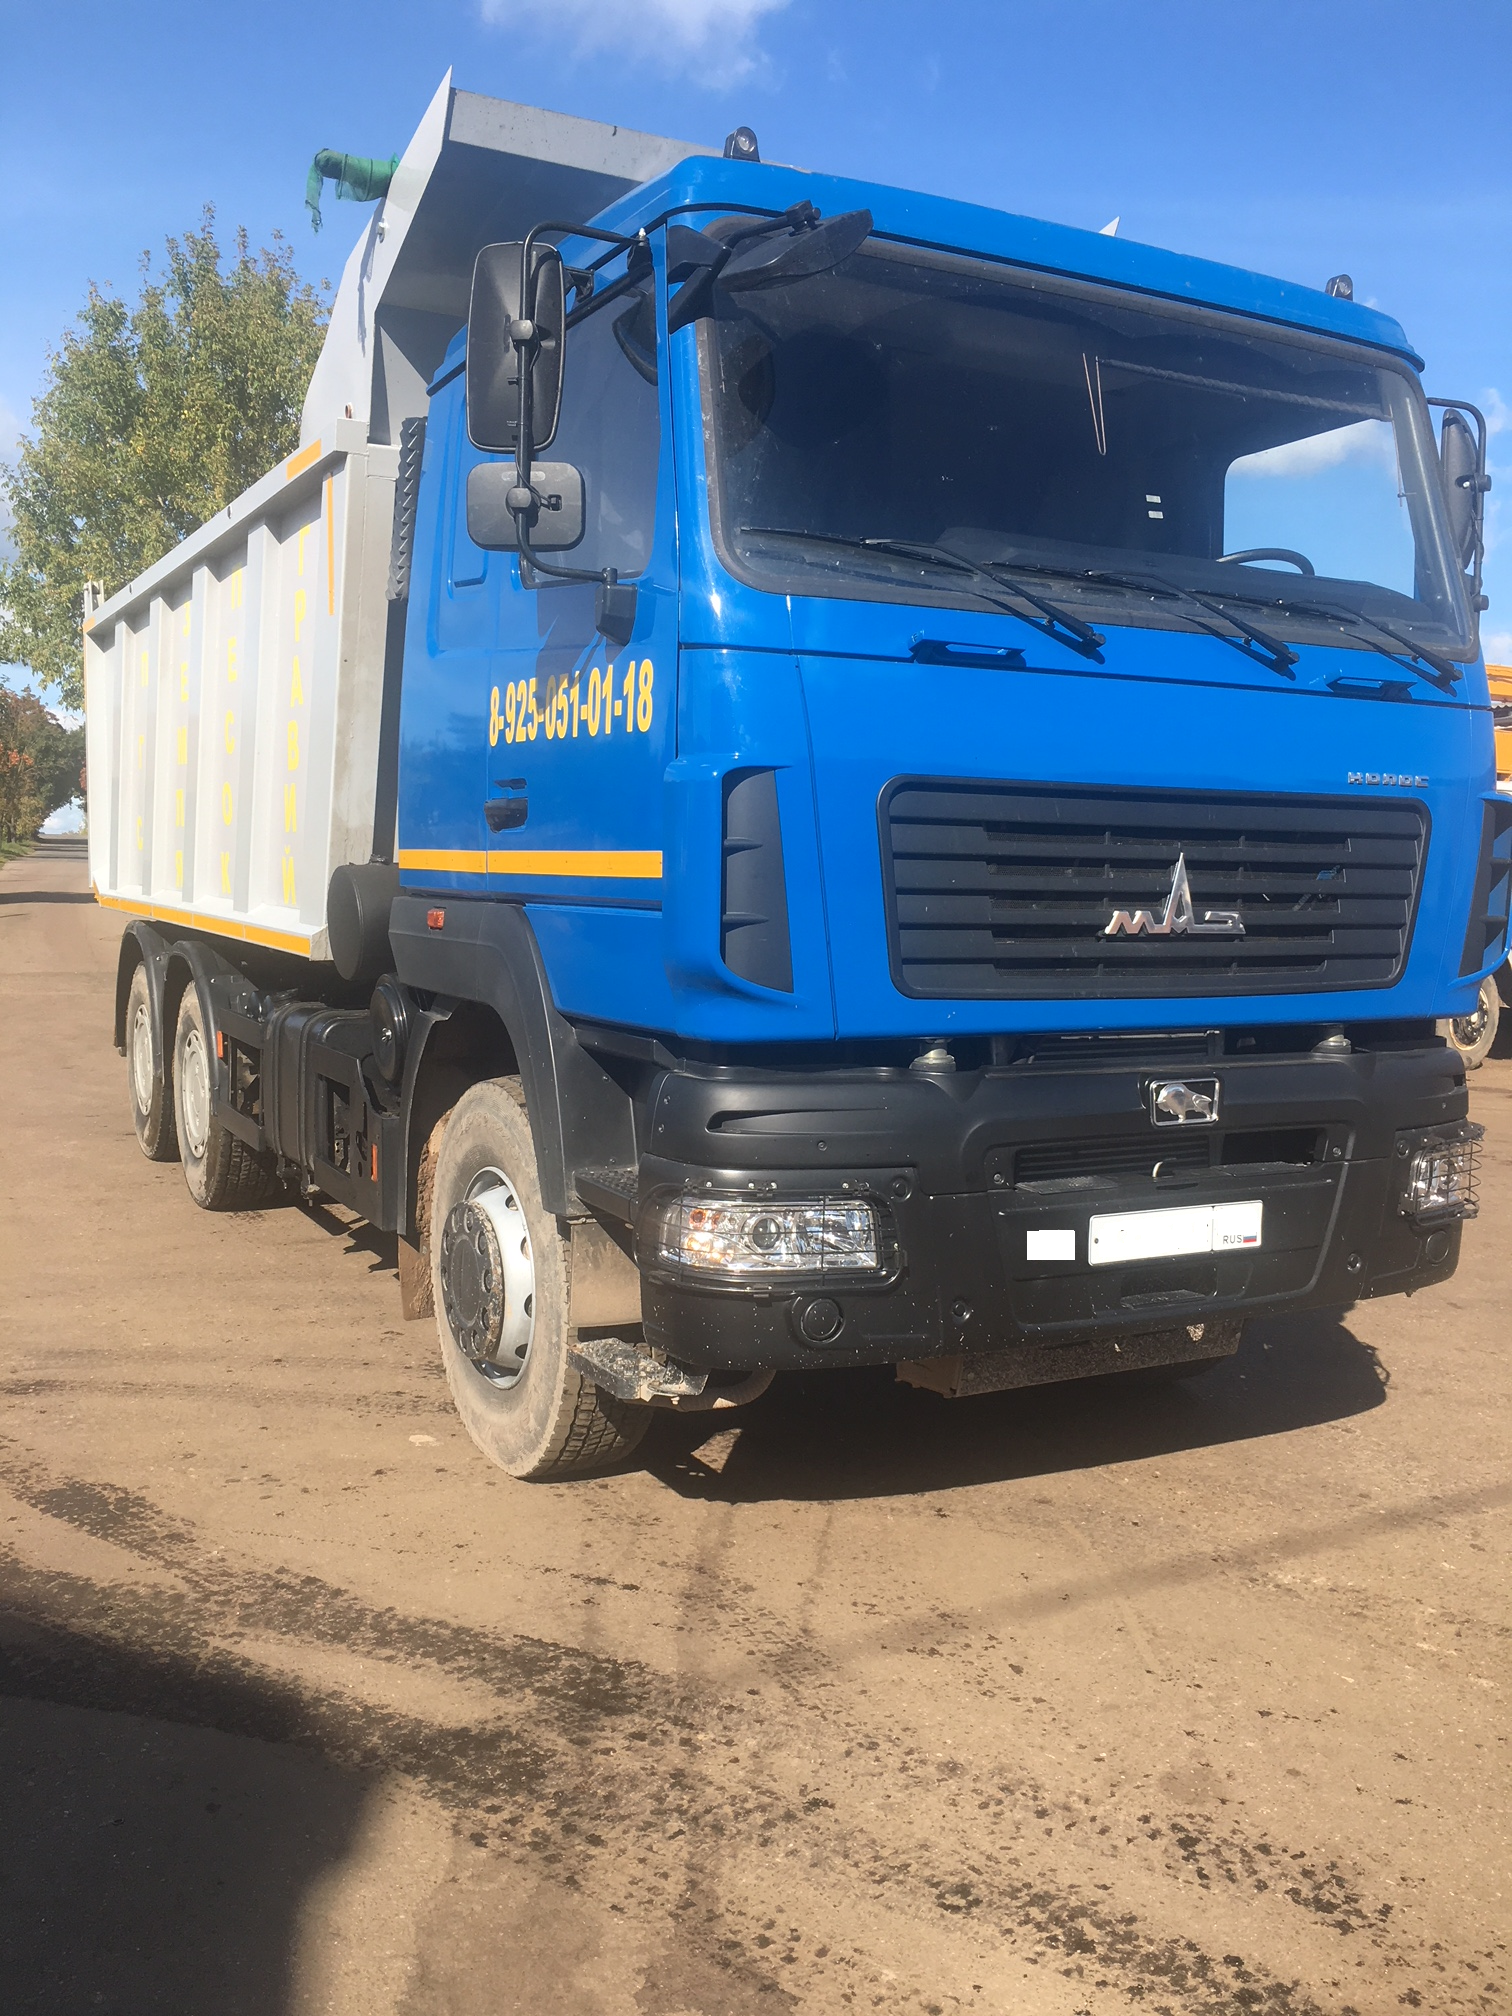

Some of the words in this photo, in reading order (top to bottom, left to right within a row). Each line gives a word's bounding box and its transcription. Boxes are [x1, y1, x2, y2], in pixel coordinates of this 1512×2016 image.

[135, 651, 149, 851] ПГС
[174, 597, 191, 889] ЗЕМЛЯ
[219, 562, 243, 895] ПЕСОК
[281, 520, 311, 906] ГРАВИЙ
[489, 658, 654, 747] 8-925-051-01-18
[1222, 1234, 1243, 1245] RUS
